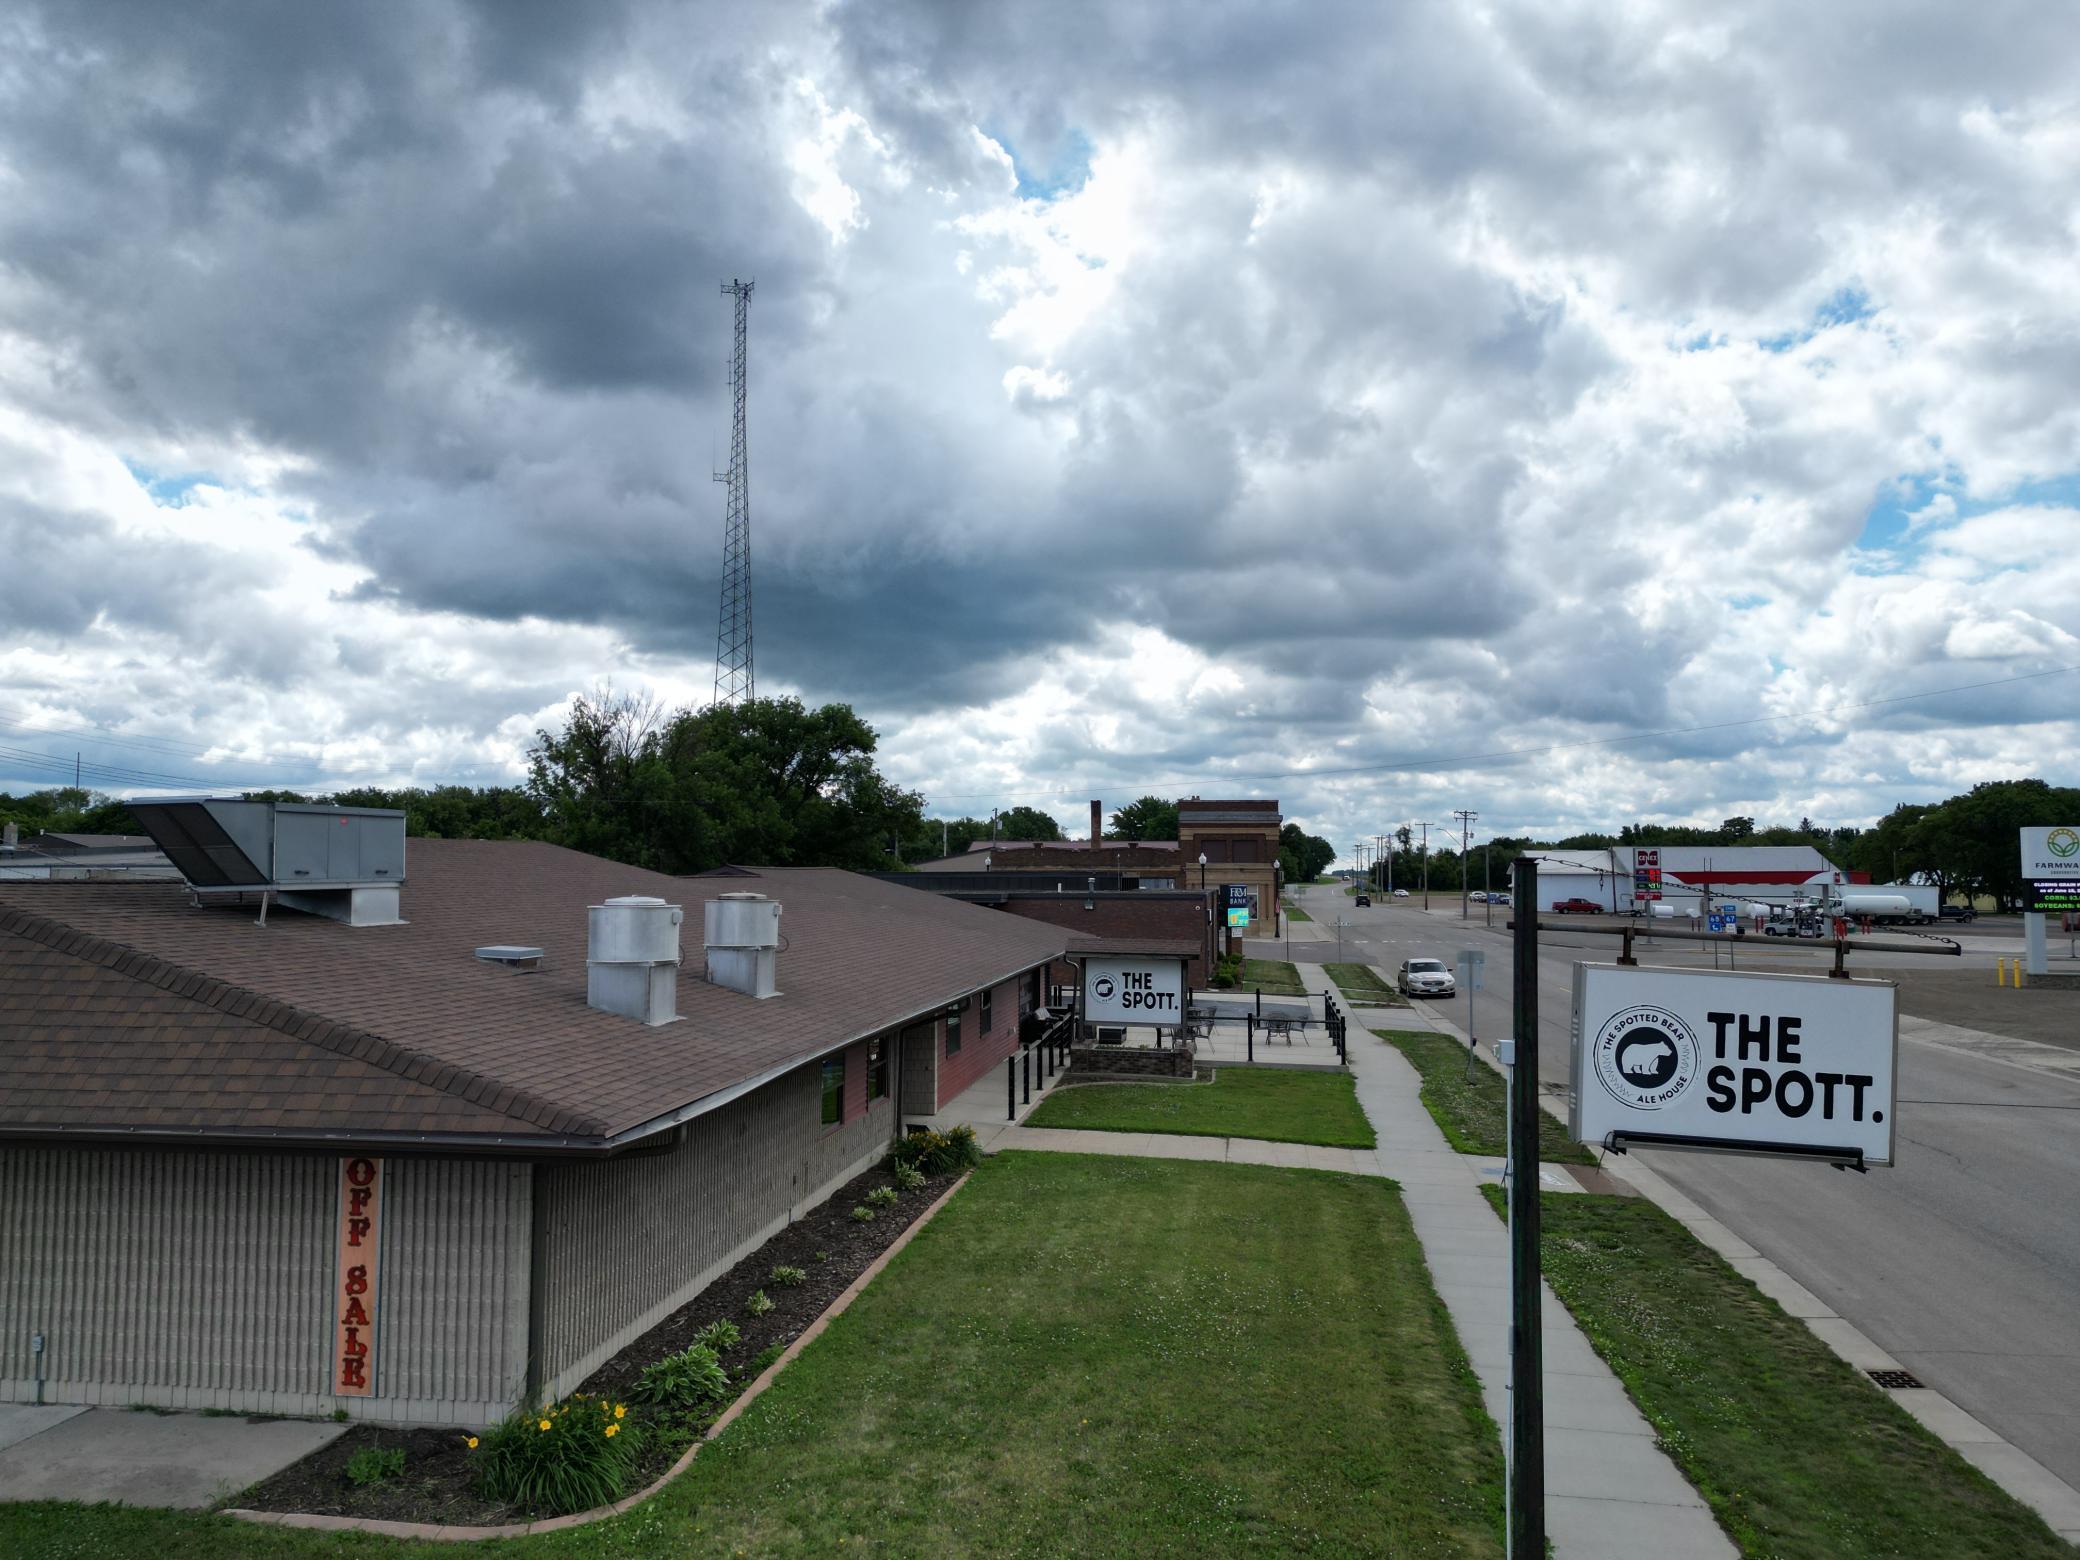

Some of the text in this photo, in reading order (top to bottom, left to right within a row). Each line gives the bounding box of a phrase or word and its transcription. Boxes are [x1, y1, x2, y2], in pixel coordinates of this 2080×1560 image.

[1122, 972, 1152, 990] THE
[1122, 992, 1178, 1009] SPOTT.
[1603, 1013, 1685, 1051] THE SPOTTED BEAR
[1707, 1011, 1802, 1064] THE
[1637, 1075, 1688, 1104] ALE HOUSE
[1707, 1065, 1884, 1124] SPOTT.
[341, 1157, 377, 1389] OFF SALE
